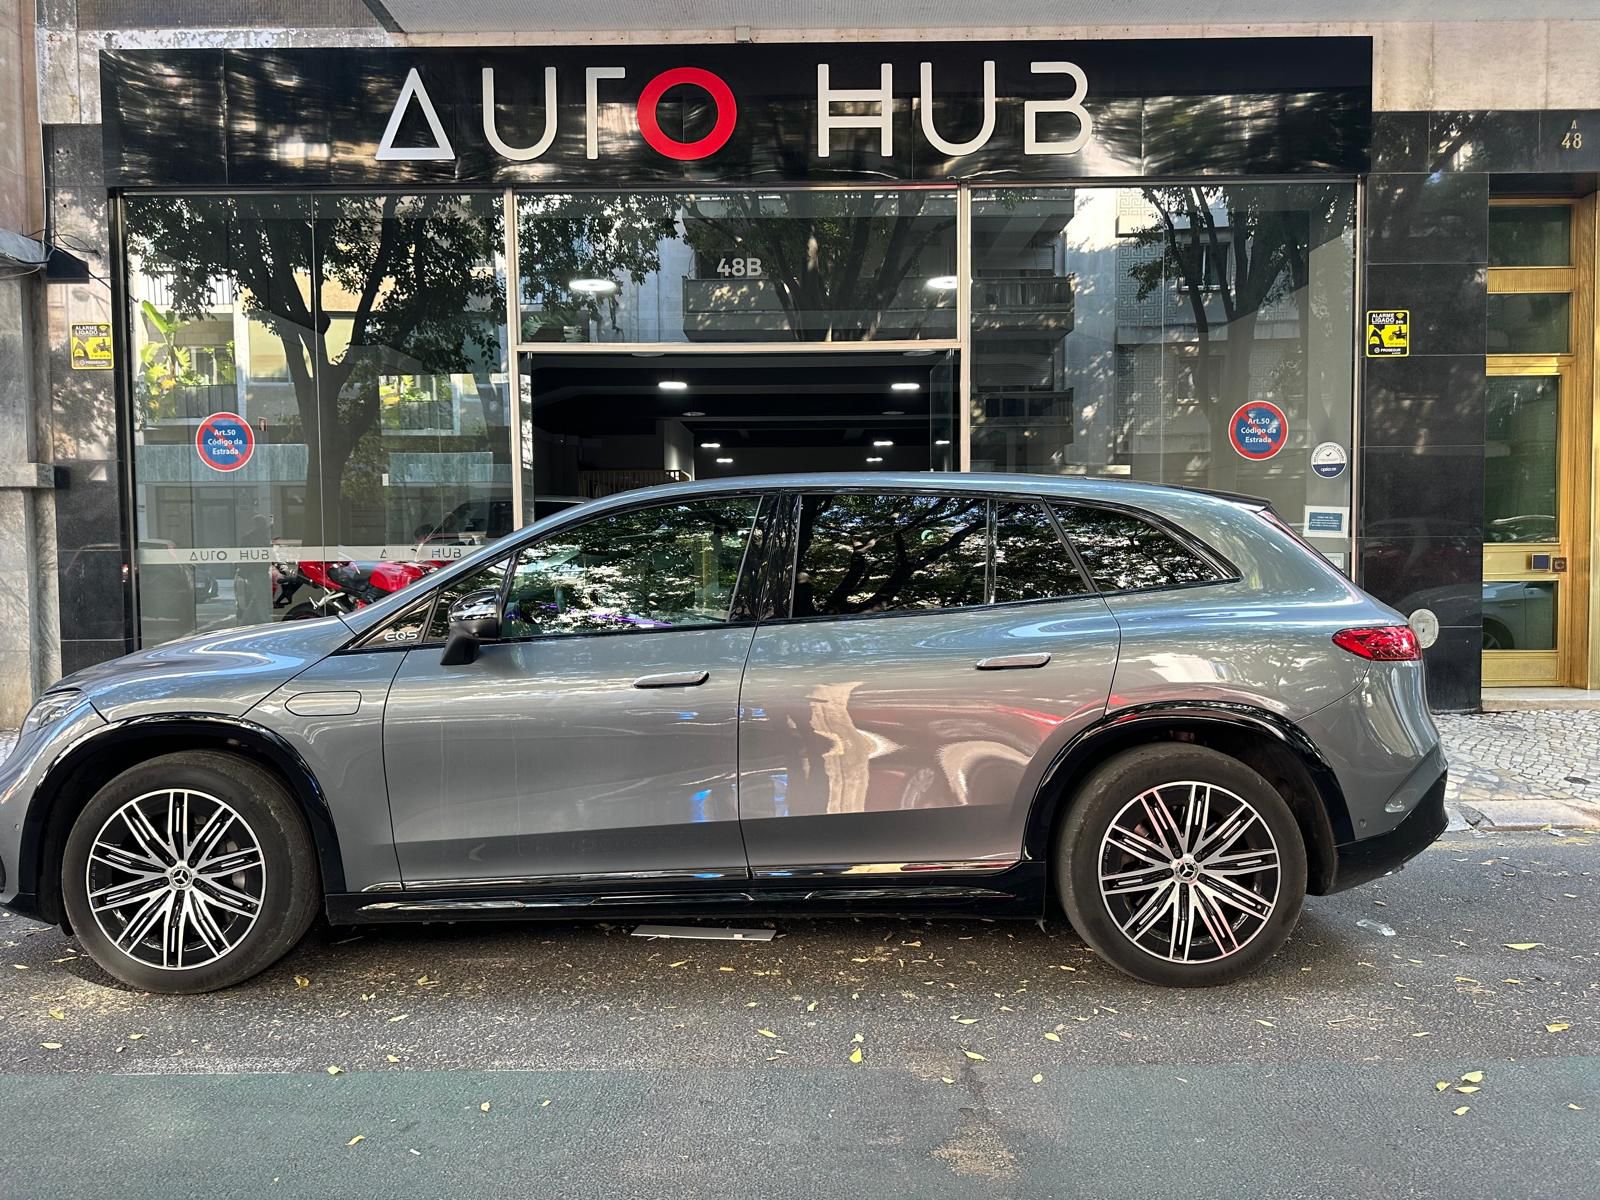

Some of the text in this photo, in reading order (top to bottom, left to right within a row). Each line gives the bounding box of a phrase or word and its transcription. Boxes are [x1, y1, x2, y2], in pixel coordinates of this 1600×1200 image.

[375, 60, 1093, 161] AUTO HUB
[1571, 119, 1577, 130] A
[1561, 132, 1582, 149] 48
[716, 257, 763, 277] 48B
[1247, 417, 1270, 425] Art.50
[1240, 426, 1266, 435] Código
[207, 438, 232, 447] Código
[212, 447, 239, 455] Estrada
[239, 549, 270, 560] HUB
[431, 548, 462, 559] HUB
[384, 631, 418, 642] EQS
